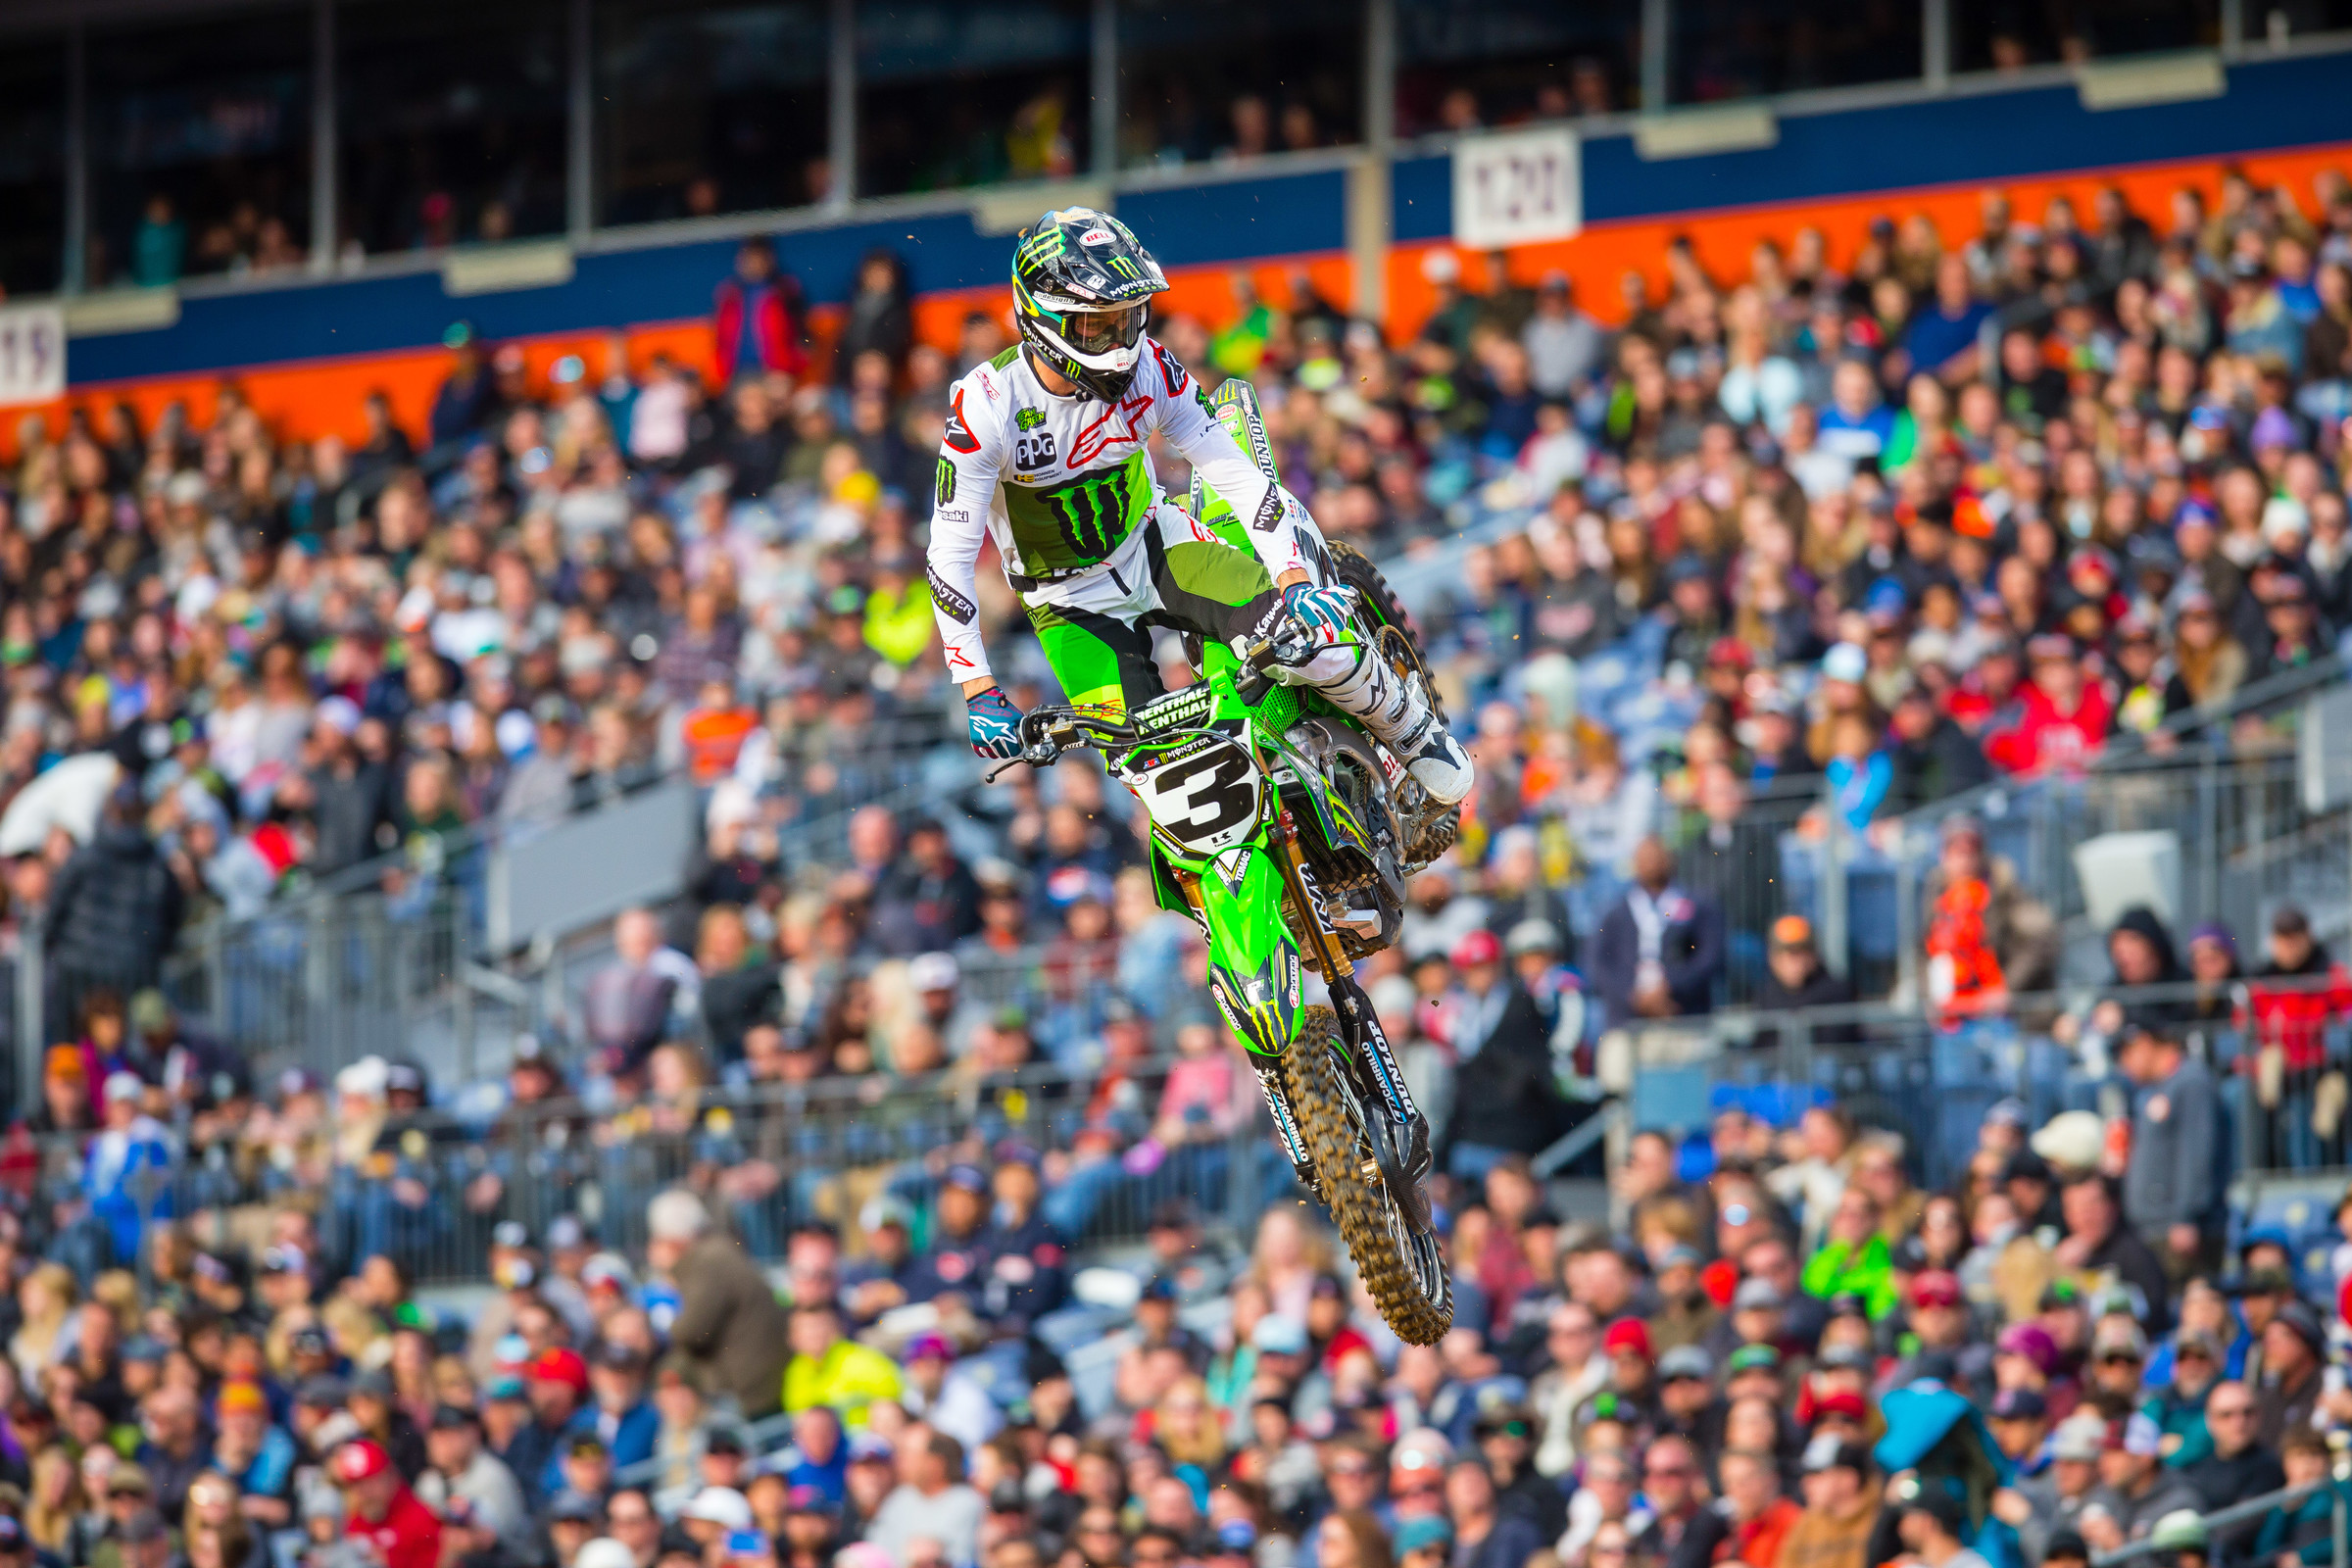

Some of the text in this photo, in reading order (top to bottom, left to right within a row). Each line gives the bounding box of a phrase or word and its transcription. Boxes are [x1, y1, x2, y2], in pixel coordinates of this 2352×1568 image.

[1086, 232, 1111, 243] BELL
[1019, 318, 1063, 365] MONSTER
[1016, 408, 1037, 422] TEAM
[1020, 411, 1045, 432] GREEN
[1247, 414, 1281, 484] DUNLOP
[1034, 471, 1062, 482] EQUIPMENT
[1255, 488, 1280, 528] MONS
[1253, 597, 1283, 639] Kawas
[1135, 688, 1208, 720] RENTHAL
[1139, 700, 1210, 736] RENTHAL
[1167, 737, 1211, 760] MONSTER
[1155, 742, 1255, 844] 3
[1152, 829, 1184, 857] Kawasaki
[1234, 850, 1251, 883] TOMAC
[1361, 1041, 1394, 1100] CARRILLO
[1367, 1019, 1417, 1116] DUNLOP
[1280, 1105, 1309, 1162] CARRILLO
